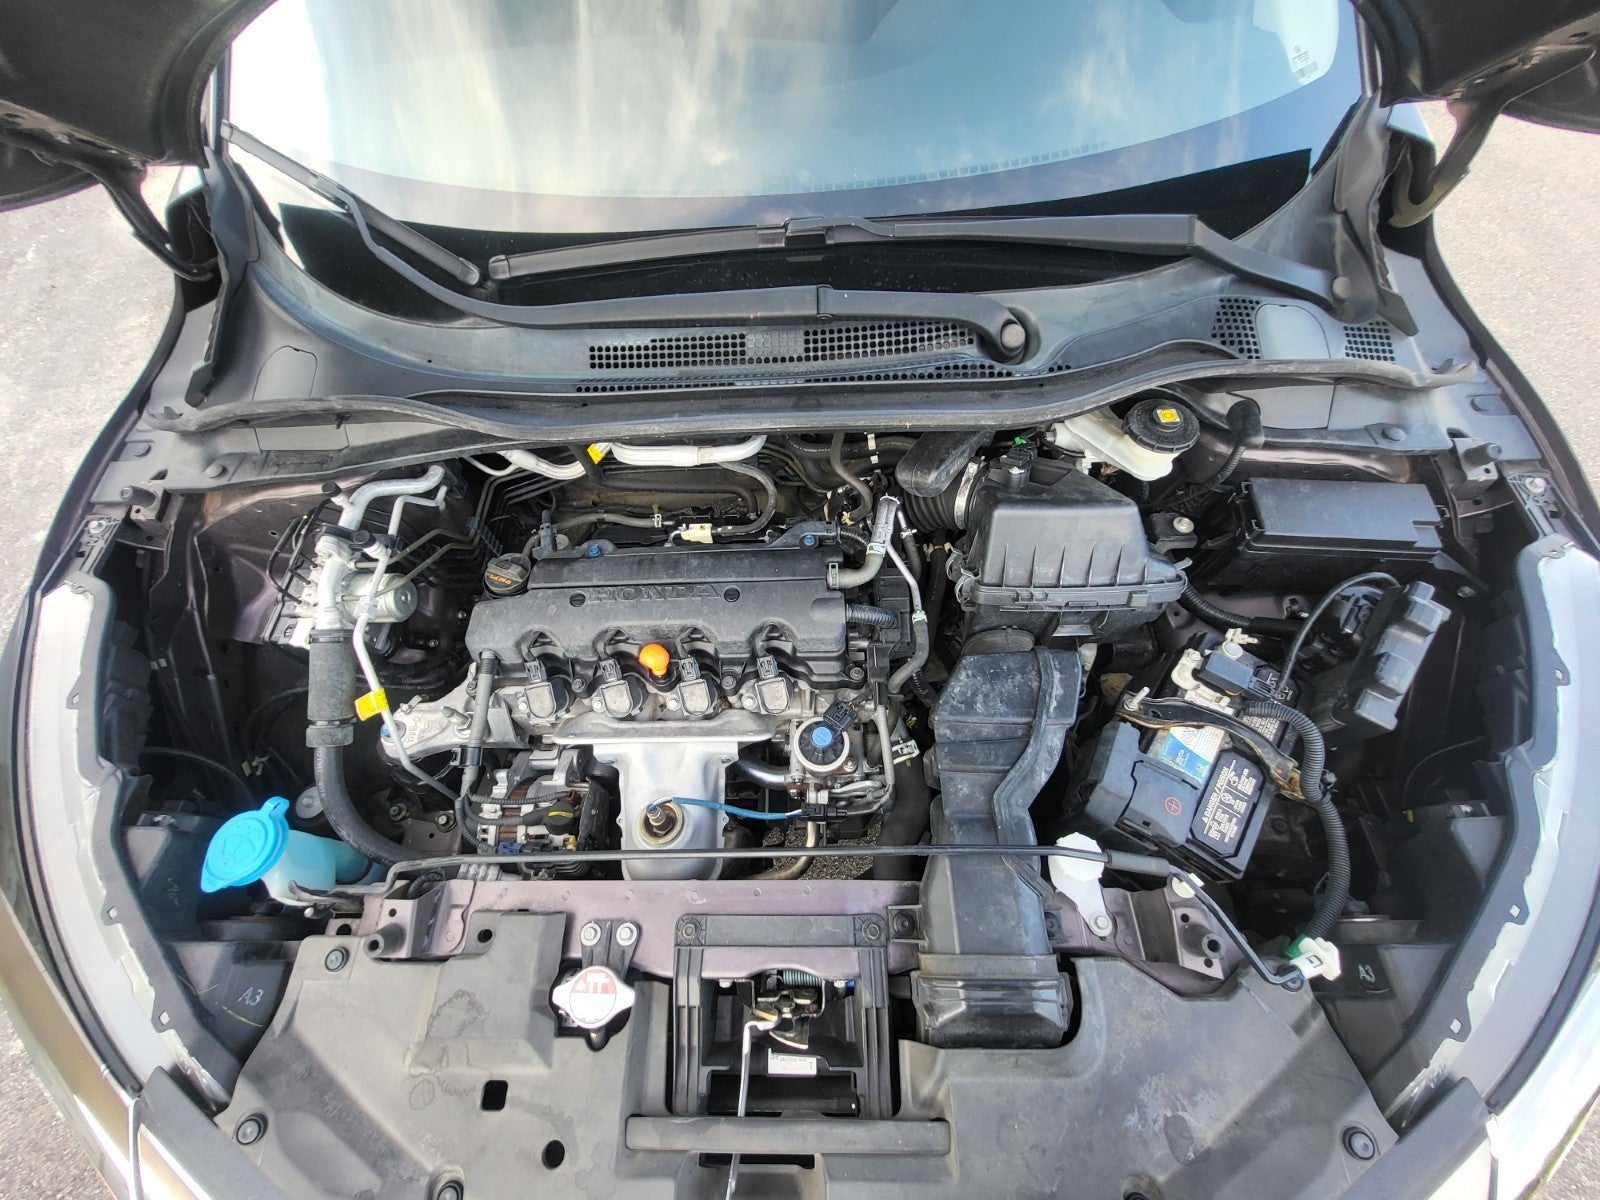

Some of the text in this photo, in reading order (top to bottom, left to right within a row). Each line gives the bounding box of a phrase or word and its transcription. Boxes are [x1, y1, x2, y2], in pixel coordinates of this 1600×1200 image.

[587, 584, 721, 603] HONDA
[1204, 792, 1218, 817] DANGER
[1216, 766, 1230, 789] POISON
[237, 986, 264, 1007] A3
